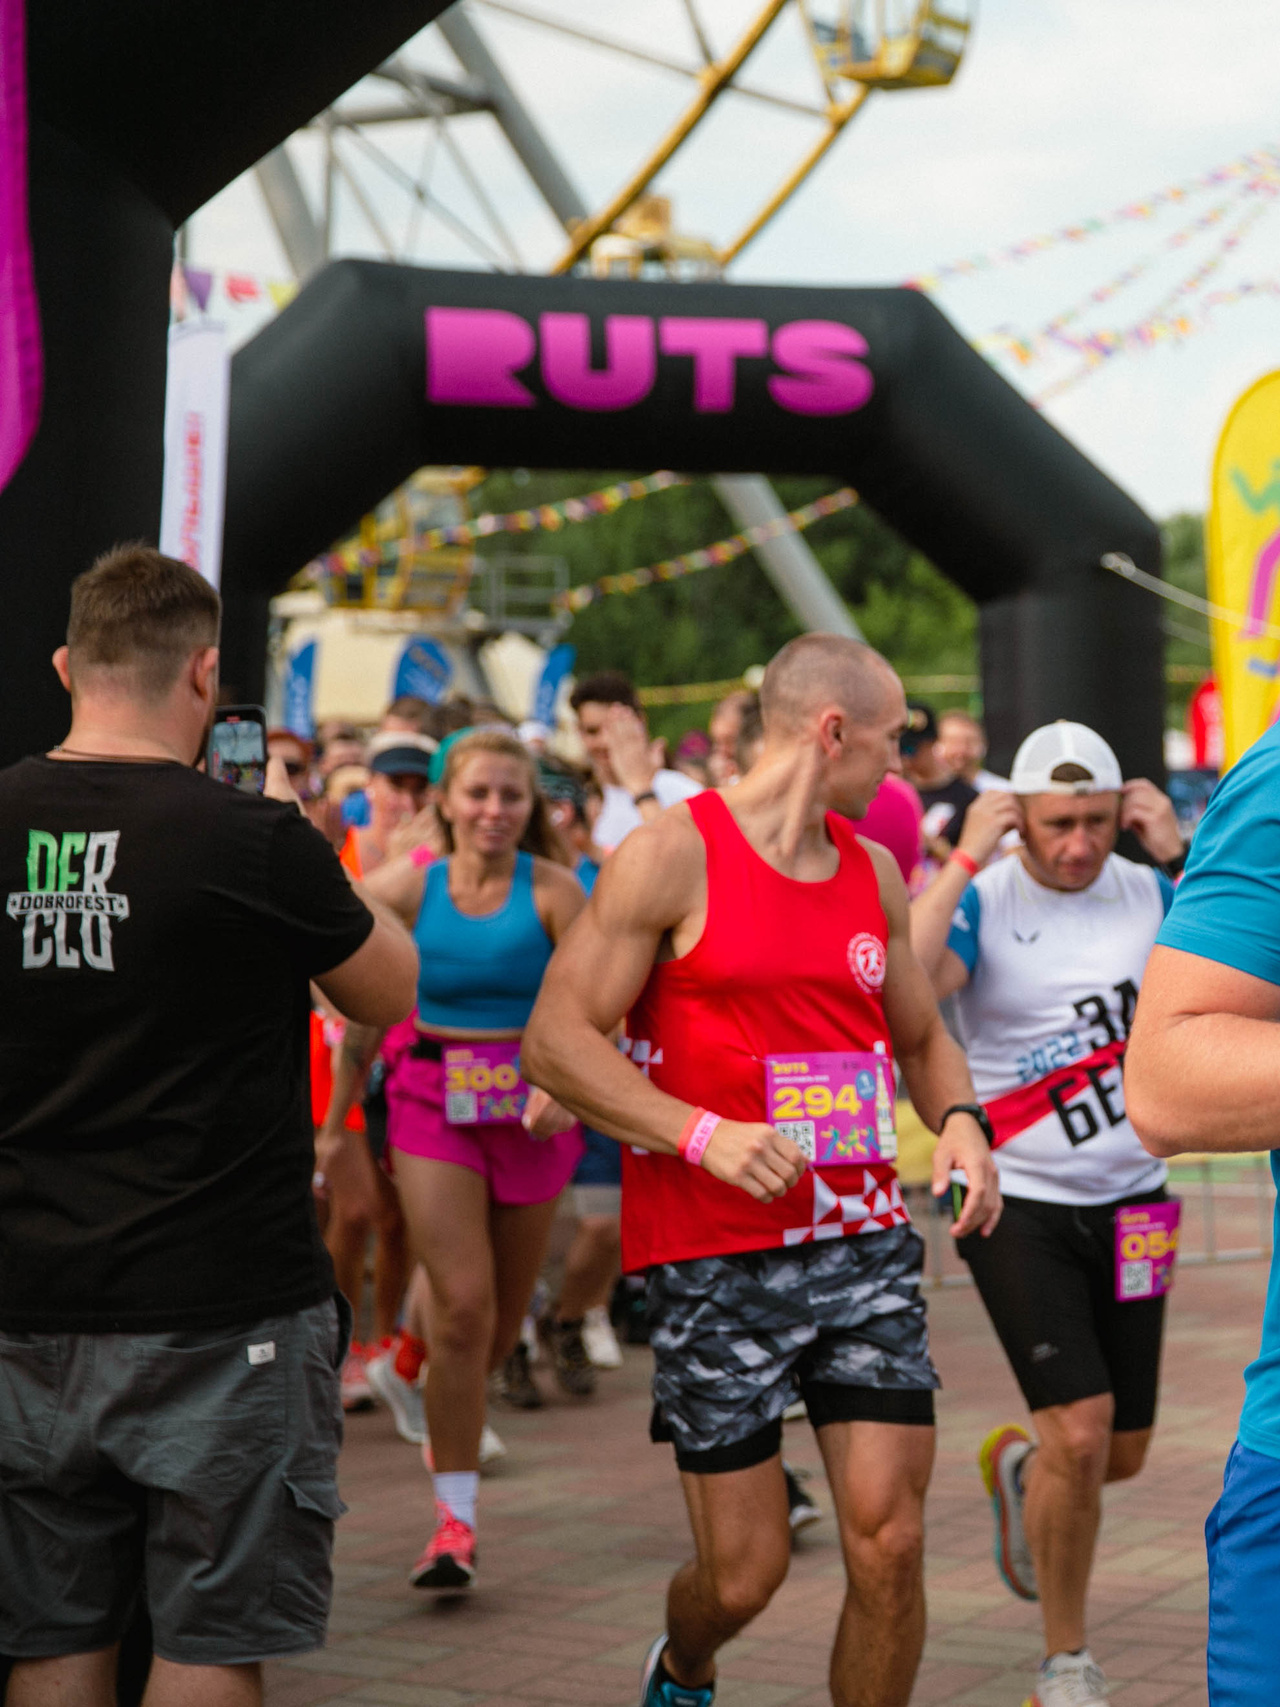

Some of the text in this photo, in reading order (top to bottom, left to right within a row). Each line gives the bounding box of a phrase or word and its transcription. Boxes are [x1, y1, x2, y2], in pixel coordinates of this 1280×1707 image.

[426, 306, 874, 416] RUTS
[19, 894, 118, 911] DOBROFEST
[445, 1064, 519, 1093] 300
[773, 1085, 863, 1119] 294
[1048, 1055, 1127, 1147] БЕ
